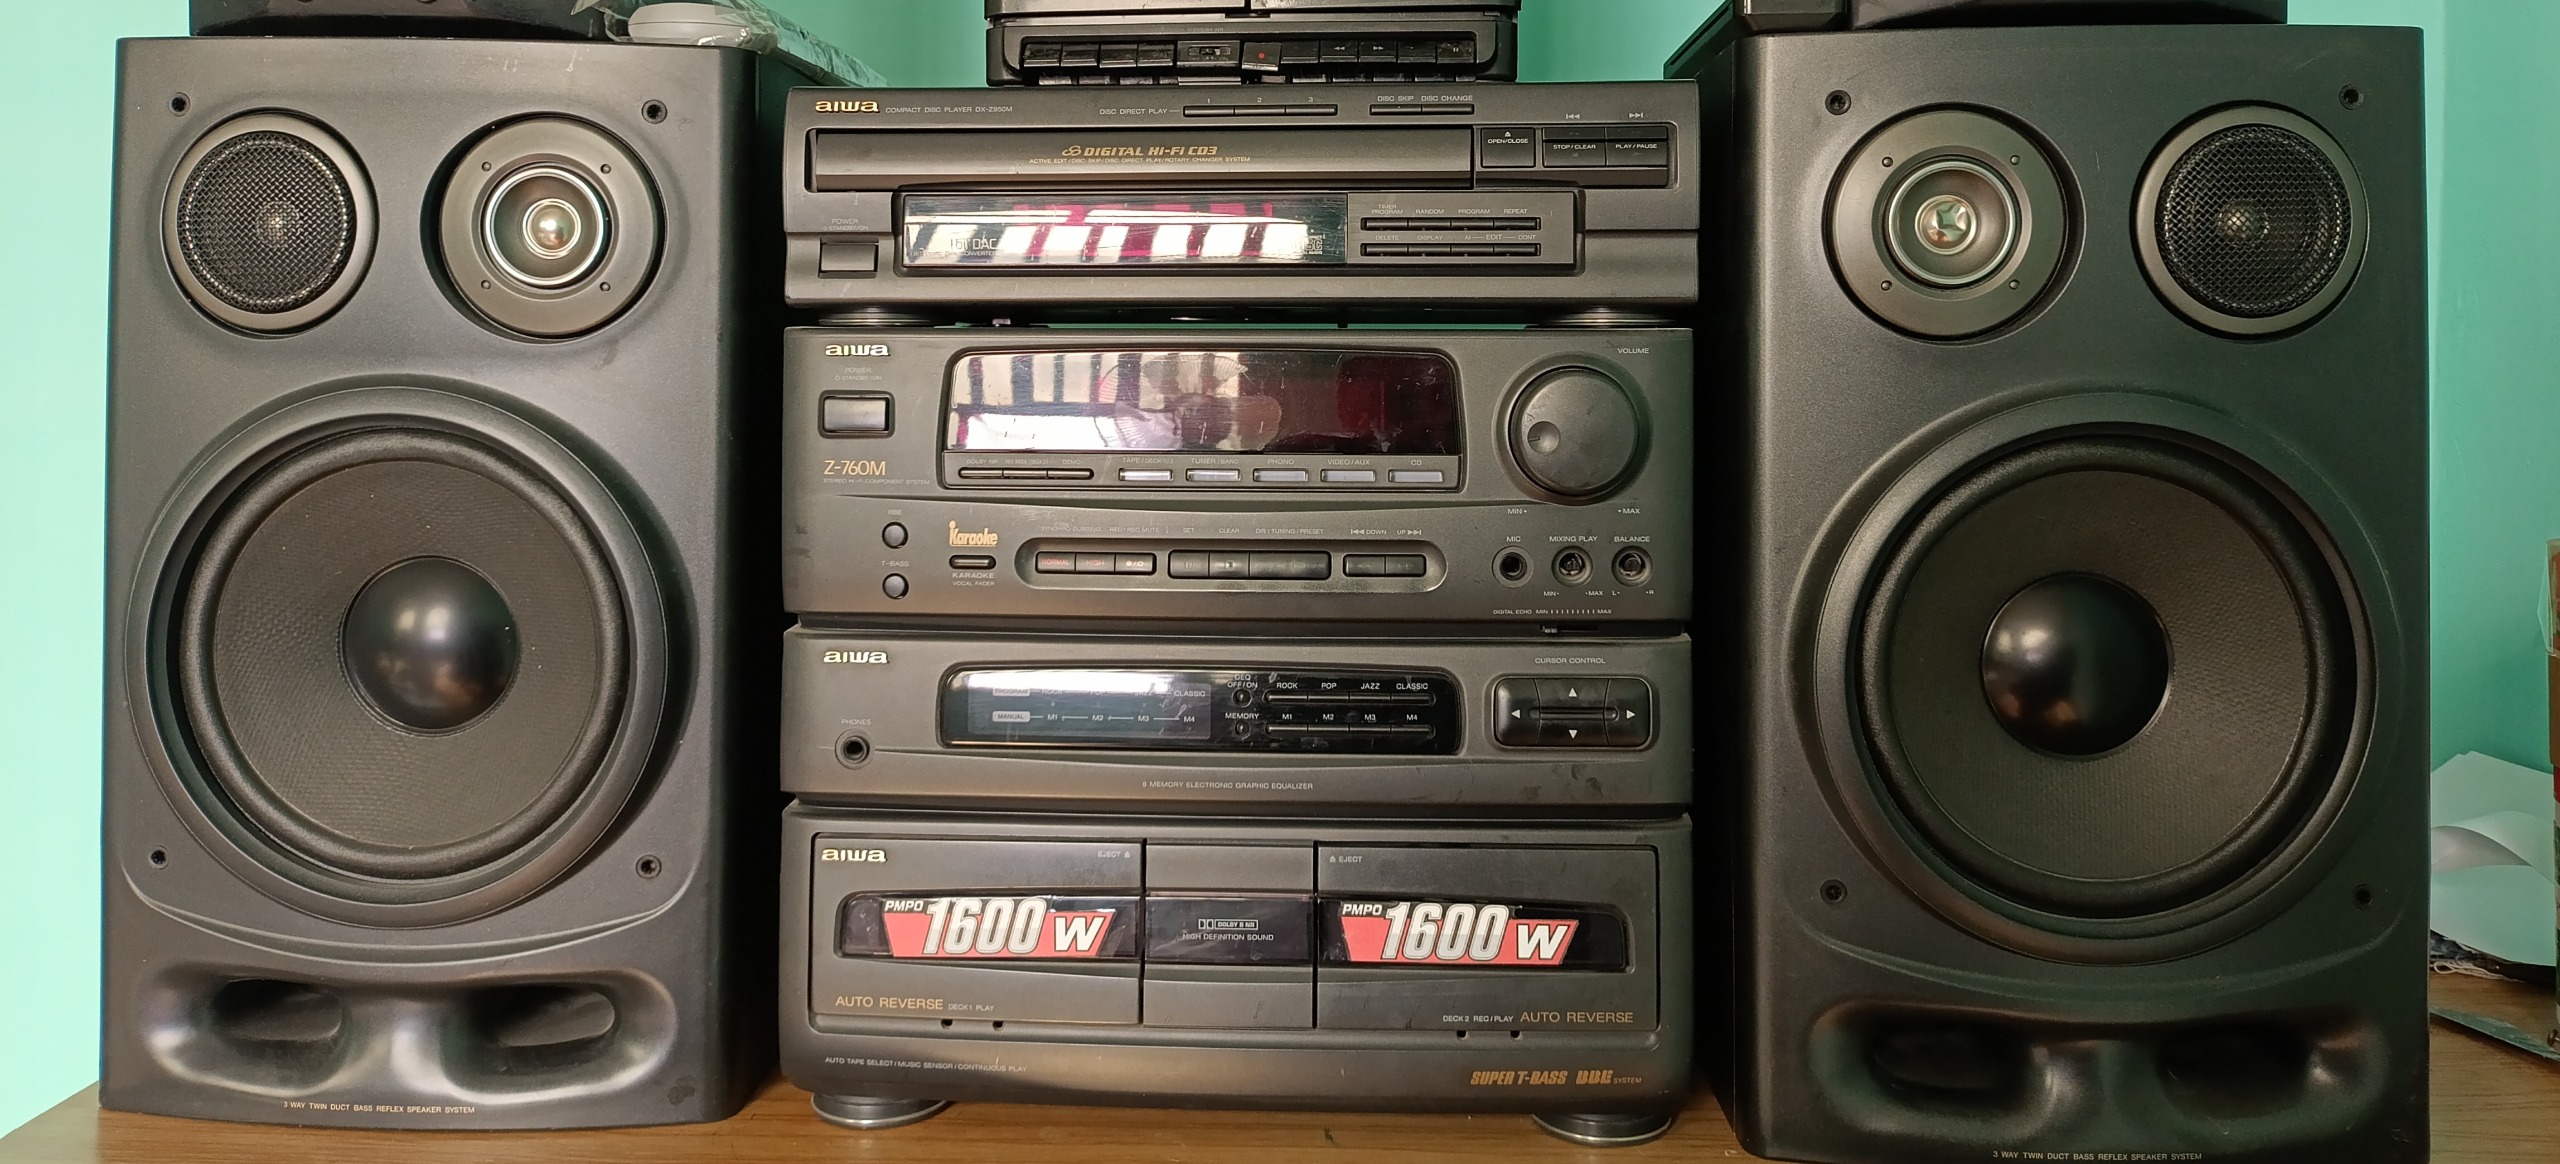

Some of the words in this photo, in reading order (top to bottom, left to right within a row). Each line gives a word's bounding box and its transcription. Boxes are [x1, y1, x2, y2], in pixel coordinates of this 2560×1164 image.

[815, 100, 880, 113] aiwa
[1084, 147, 1144, 156] DIGITAL
[1187, 146, 1218, 155] CD3
[972, 238, 997, 249] DAC
[825, 344, 890, 356] aiwa
[824, 460, 886, 475] Z-760M
[824, 651, 889, 664] aiwa
[821, 848, 887, 863] aiwa
[884, 900, 924, 912] PMPO
[922, 897, 1048, 956] 1600
[1054, 916, 1105, 952] W
[1342, 904, 1383, 915] PMPO
[1380, 901, 1509, 961] 1600
[1516, 924, 1568, 960] W
[835, 996, 874, 1008] AUTO
[880, 998, 944, 1010] REVERSE
[1520, 1012, 1560, 1023] AUTO
[1567, 1012, 1633, 1023] REVERSE
[1471, 1071, 1514, 1085] SUPER
[1517, 1071, 1568, 1085] T-BASS
[1576, 1070, 1613, 1084] BBE
